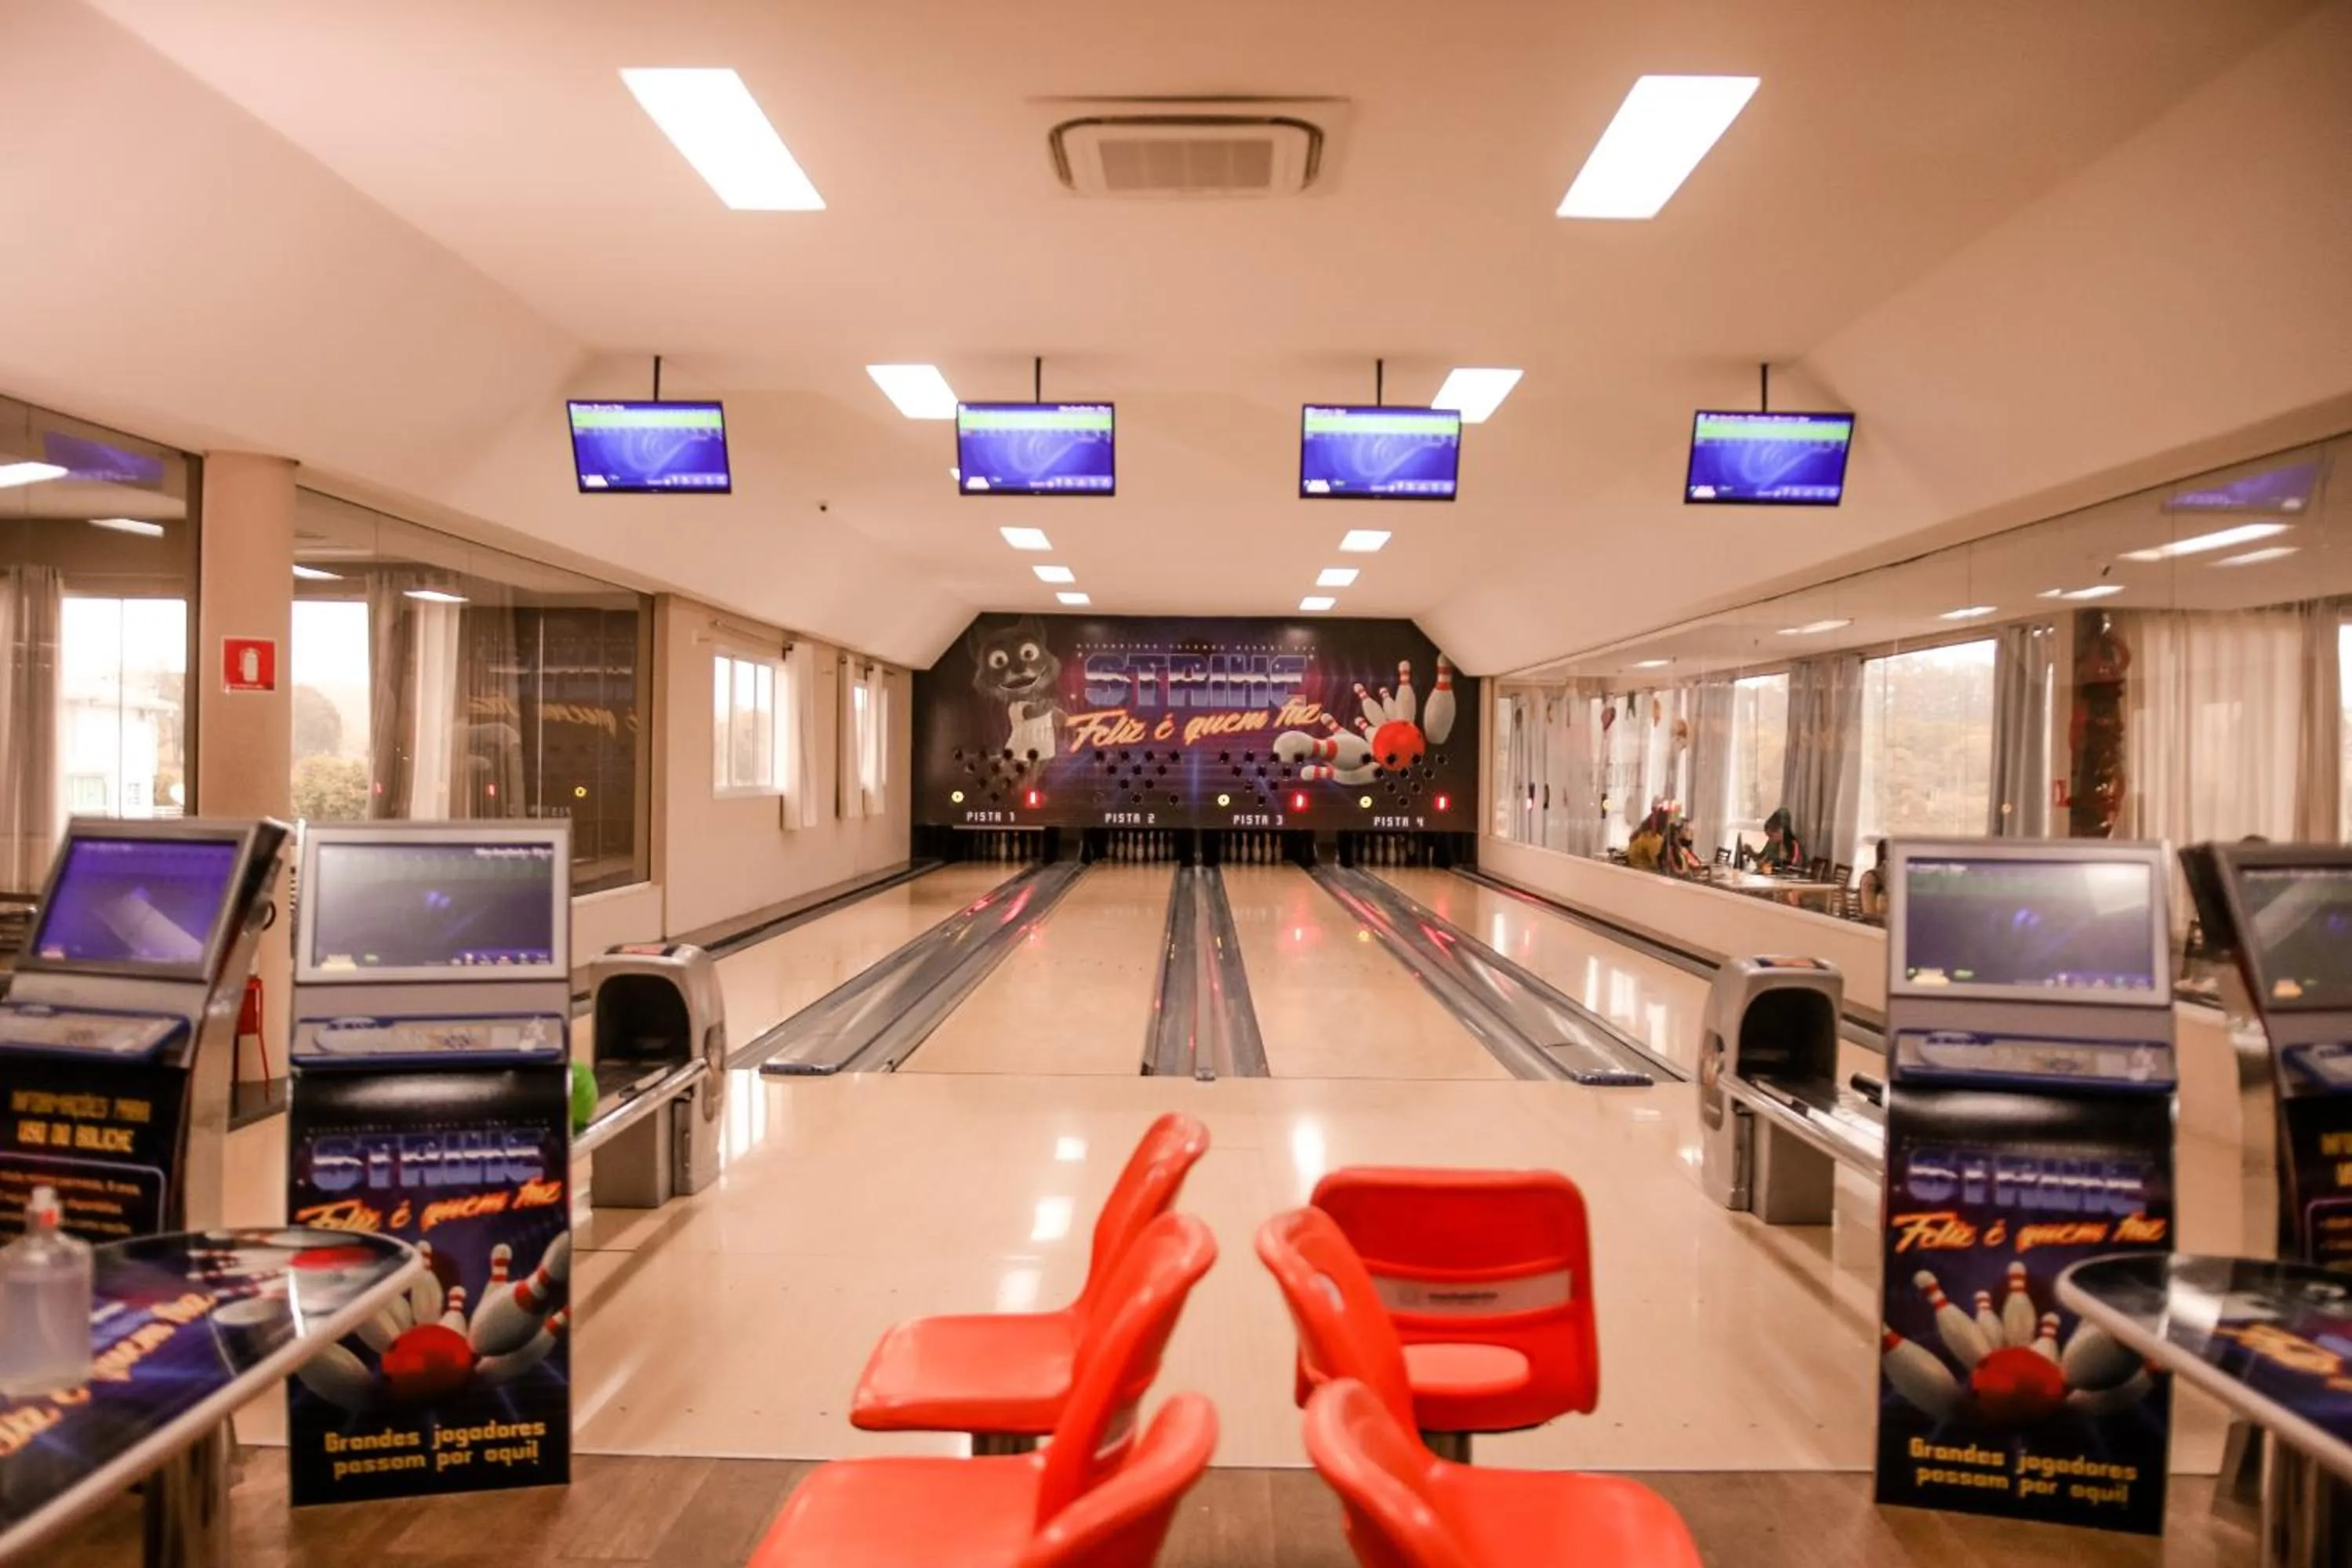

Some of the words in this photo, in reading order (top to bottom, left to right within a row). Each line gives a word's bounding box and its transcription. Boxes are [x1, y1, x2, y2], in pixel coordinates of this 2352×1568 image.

[1085, 653, 1307, 706] STRIKE
[1065, 708, 1147, 753] Feliz
[1154, 712, 1175, 739] é
[1184, 710, 1269, 745] quem
[1272, 695, 1323, 726] faz
[966, 811, 1002, 822] PISTA
[1008, 811, 1017, 822] 1
[1105, 812, 1141, 824] PISTA
[1147, 812, 1156, 824] 2
[1233, 814, 1269, 826] PISTA
[1275, 814, 1283, 826] 3
[1373, 815, 1410, 827] PISTA
[1416, 816, 1425, 828] 4
[324, 1426, 421, 1452] Grandes
[432, 1418, 546, 1450] jogadores
[333, 1453, 427, 1481] passam
[436, 1450, 474, 1472] por
[484, 1438, 540, 1467] aqui!
[1909, 1436, 2005, 1467] Grandes
[2016, 1449, 2138, 1481] jogadores
[1915, 1466, 2009, 1489] passam
[2019, 1476, 2059, 1498] por
